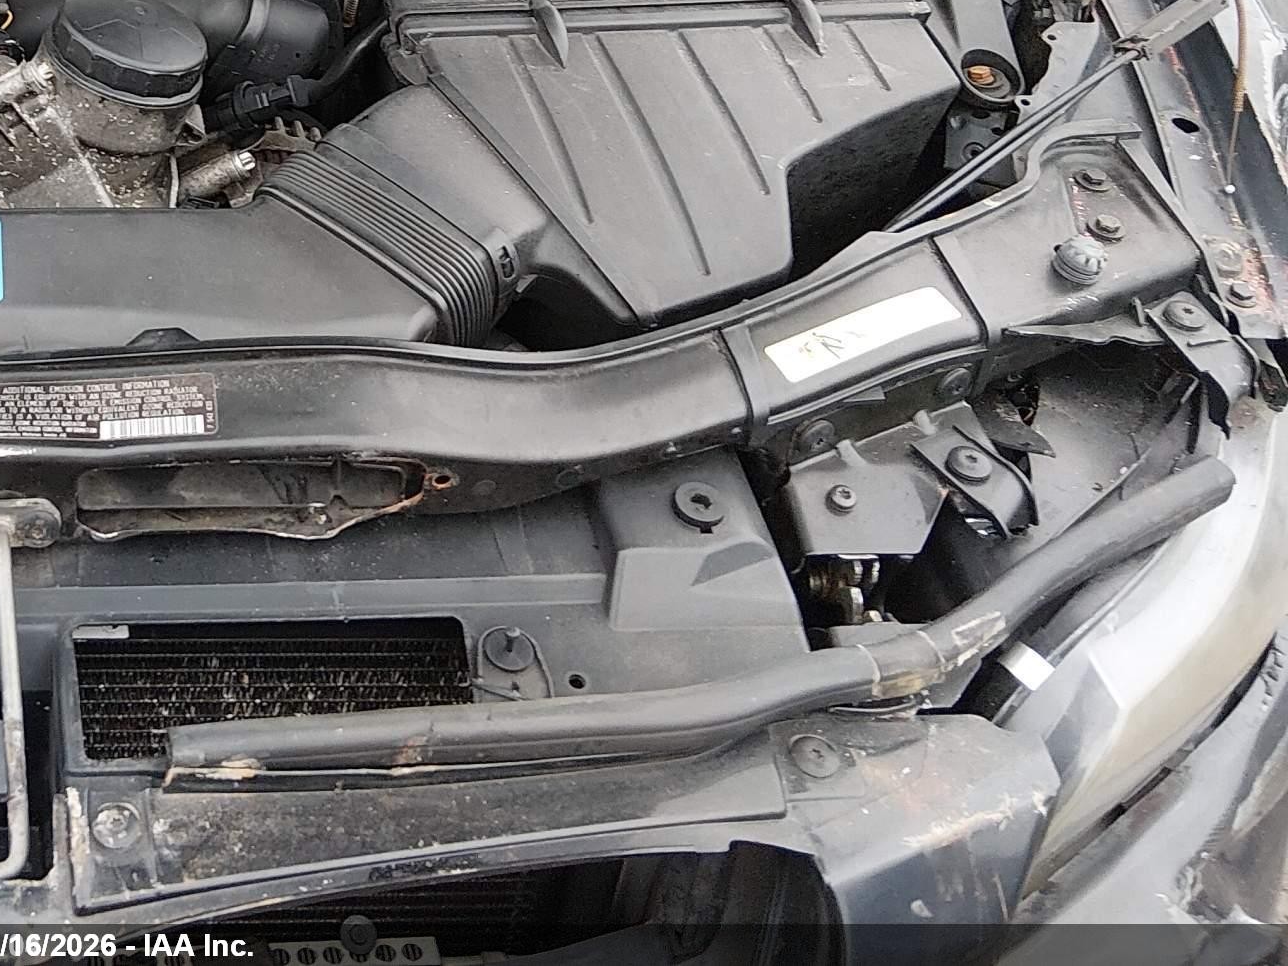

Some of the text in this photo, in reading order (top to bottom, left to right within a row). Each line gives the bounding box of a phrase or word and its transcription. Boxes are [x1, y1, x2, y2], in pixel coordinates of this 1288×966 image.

[2, 379, 170, 394] ADDITIONAL EMISSION CONTROL INFORMATION
[125, 389, 162, 397] REDUCTION
[164, 386, 198, 394] RADIATOR
[166, 400, 204, 408] REDUCTION
